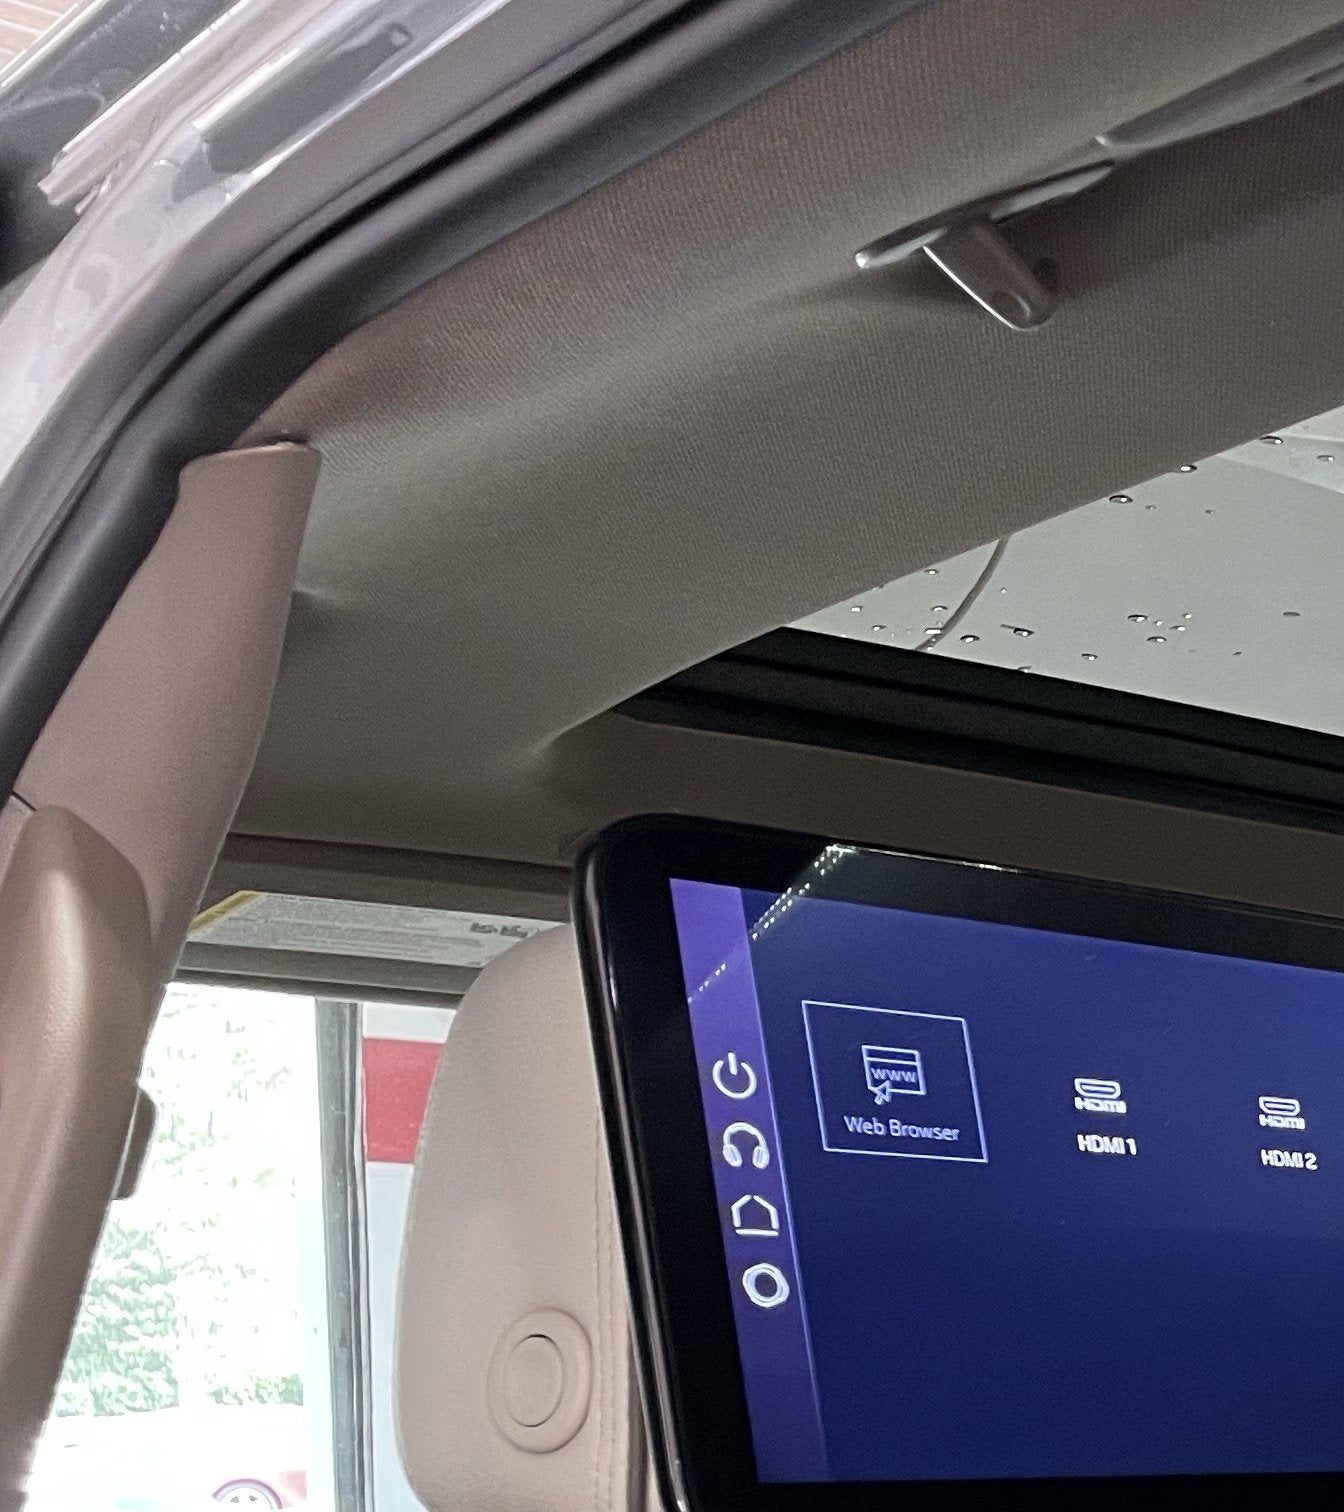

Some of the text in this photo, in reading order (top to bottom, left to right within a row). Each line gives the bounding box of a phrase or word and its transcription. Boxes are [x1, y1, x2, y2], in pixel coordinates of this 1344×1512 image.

[843, 1115, 961, 1141] Web Browser
[1076, 1134, 1138, 1156] HDMI 1
[1260, 1149, 1318, 1170] HDMI 2
